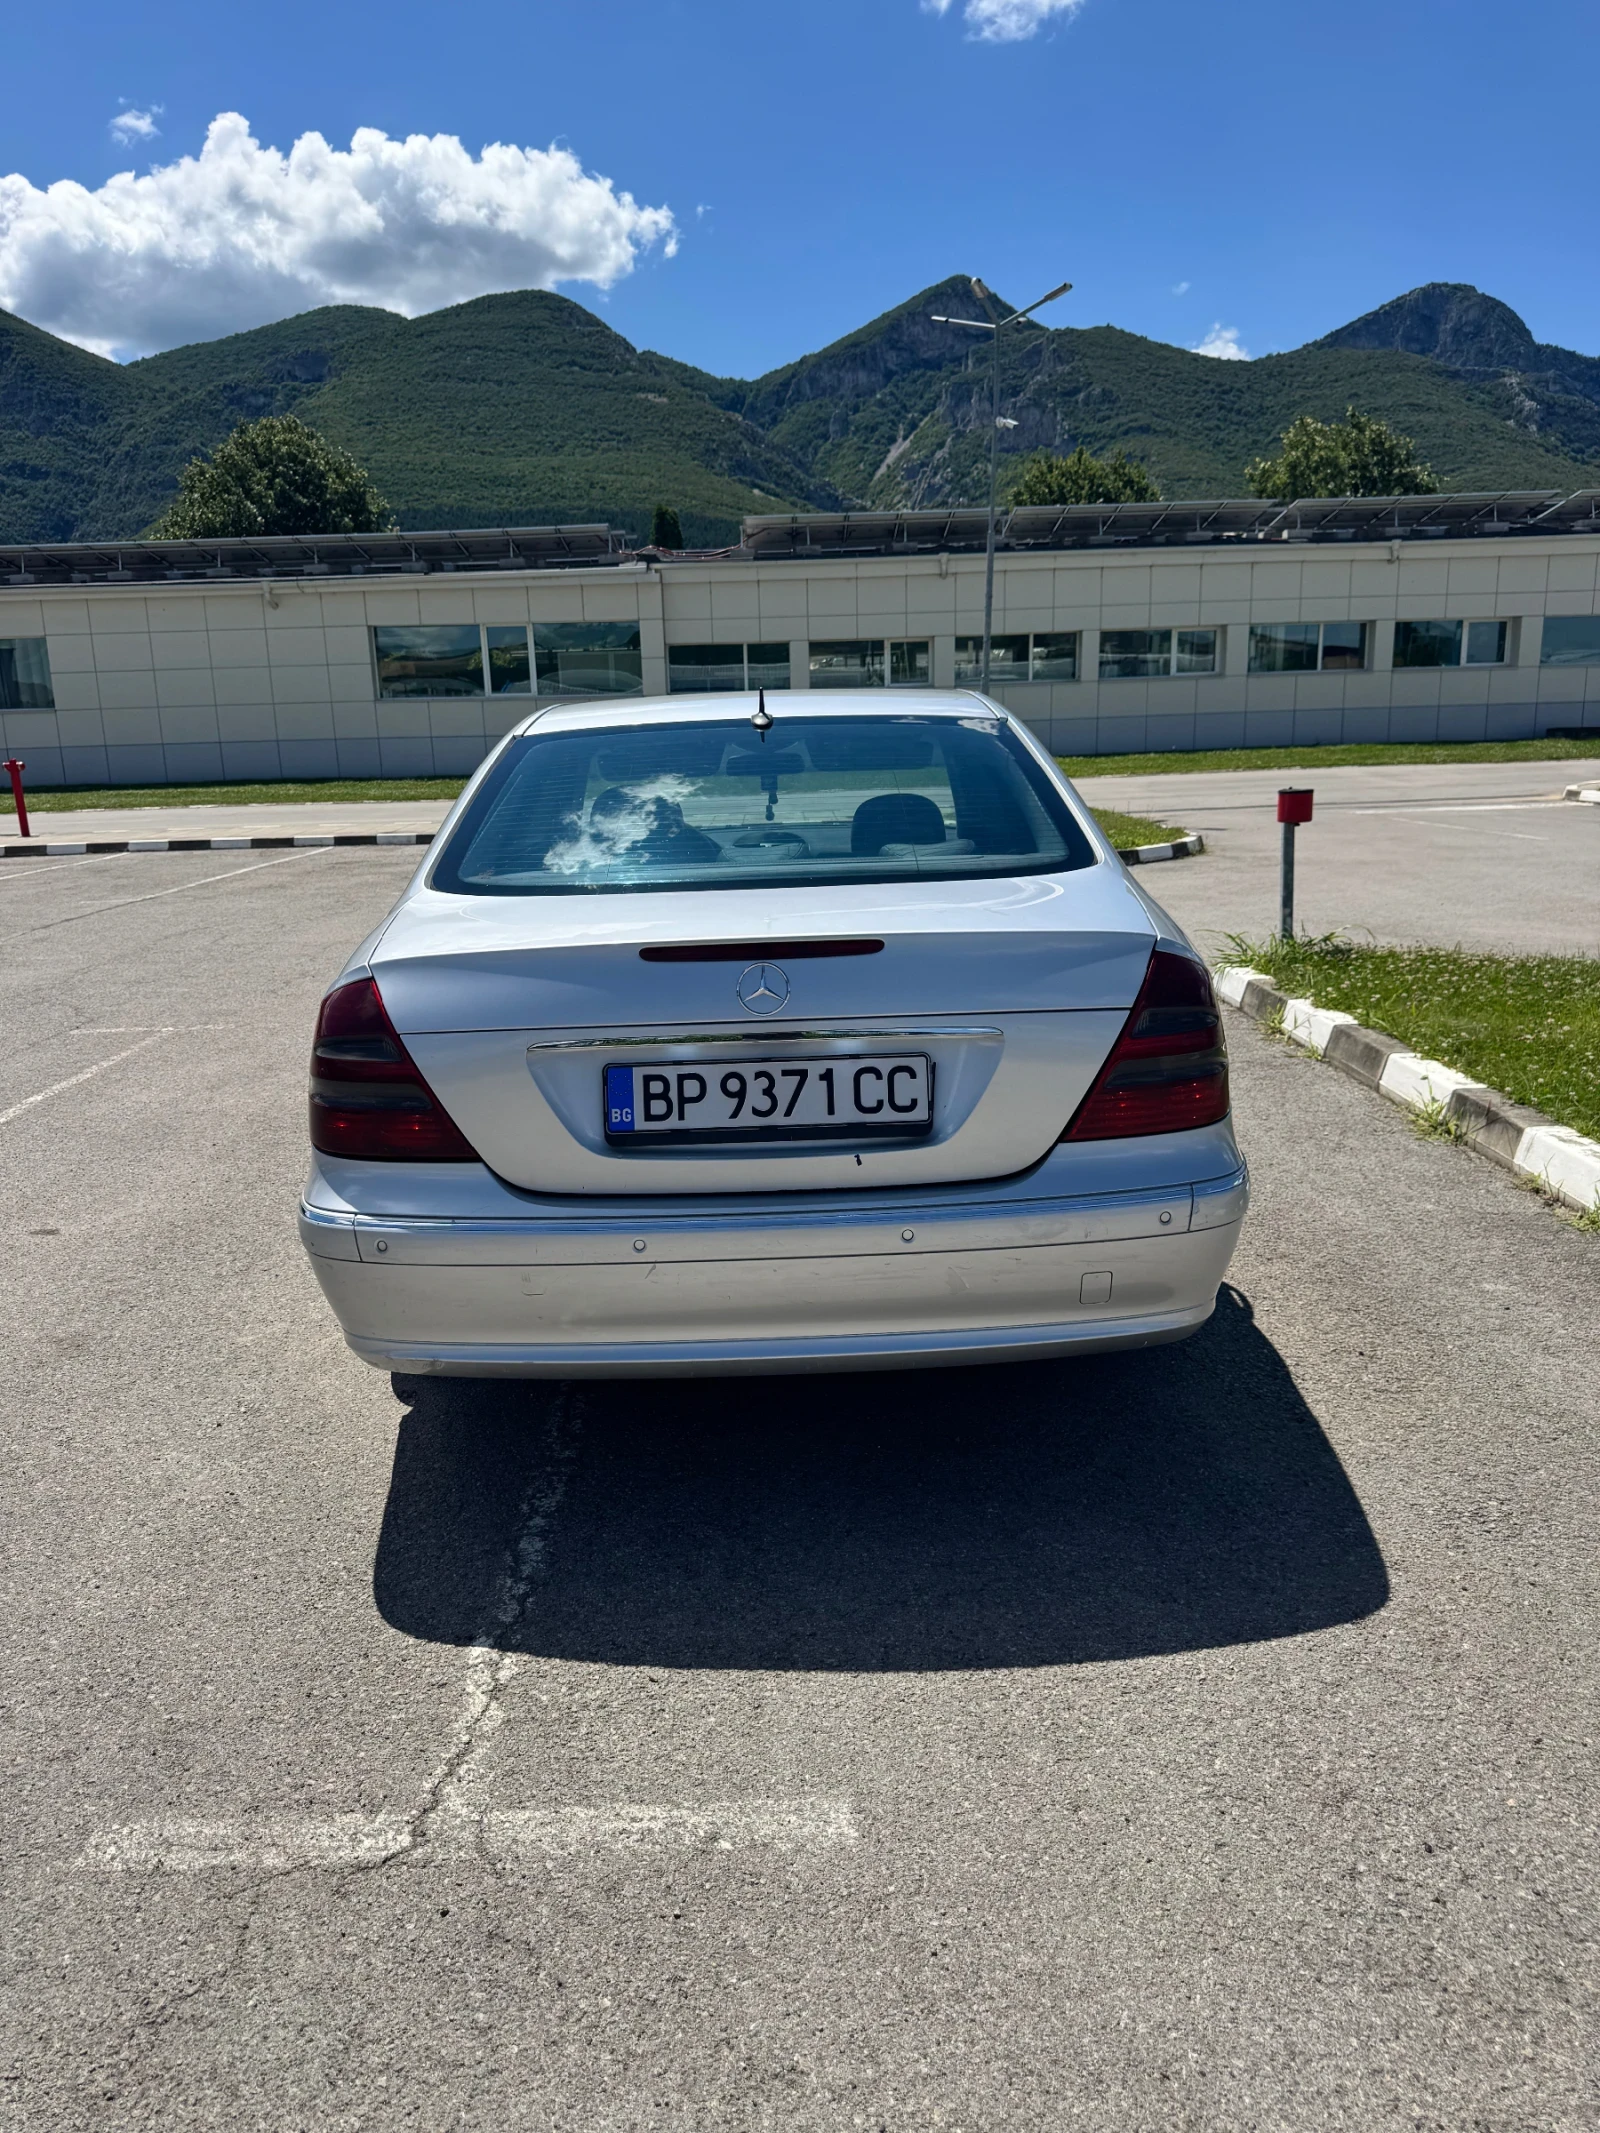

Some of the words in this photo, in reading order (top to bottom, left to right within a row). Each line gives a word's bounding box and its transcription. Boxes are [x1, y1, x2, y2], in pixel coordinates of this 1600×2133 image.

[642, 1072, 707, 1122] BP
[720, 1068, 835, 1119] 9371
[853, 1065, 918, 1115] CC
[611, 1108, 632, 1123] BG
